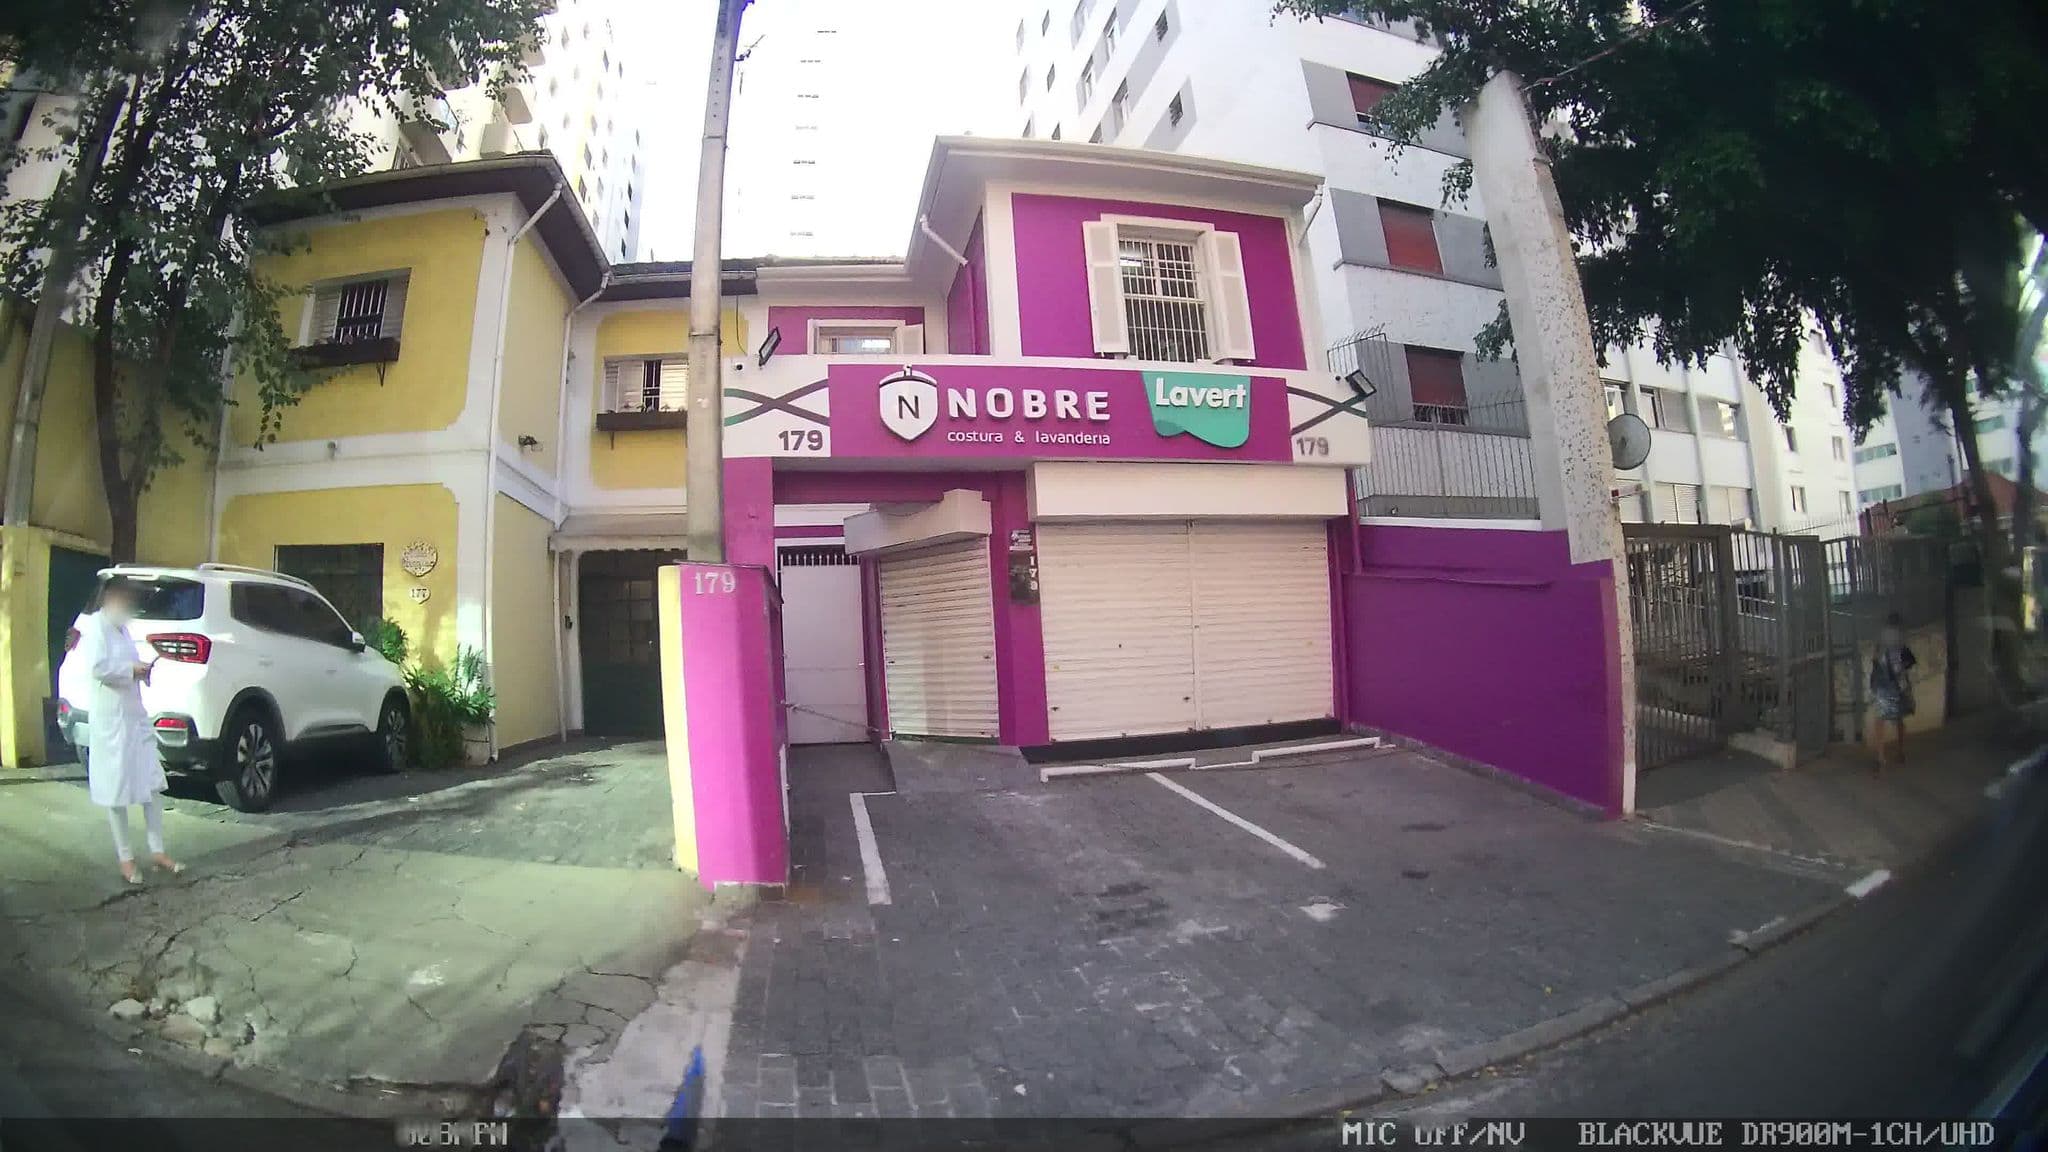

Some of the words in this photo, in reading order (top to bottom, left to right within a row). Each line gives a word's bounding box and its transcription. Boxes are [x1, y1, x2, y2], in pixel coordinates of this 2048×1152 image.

[946, 387, 1111, 421] NOBRE
[1155, 377, 1247, 408] Lavert
[897, 394, 921, 420] N
[777, 429, 824, 451] 179
[946, 430, 1004, 443] costura
[1014, 430, 1026, 443] &
[1035, 430, 1111, 445] lavanderia
[1295, 436, 1330, 457] 179
[694, 571, 737, 595] 179
